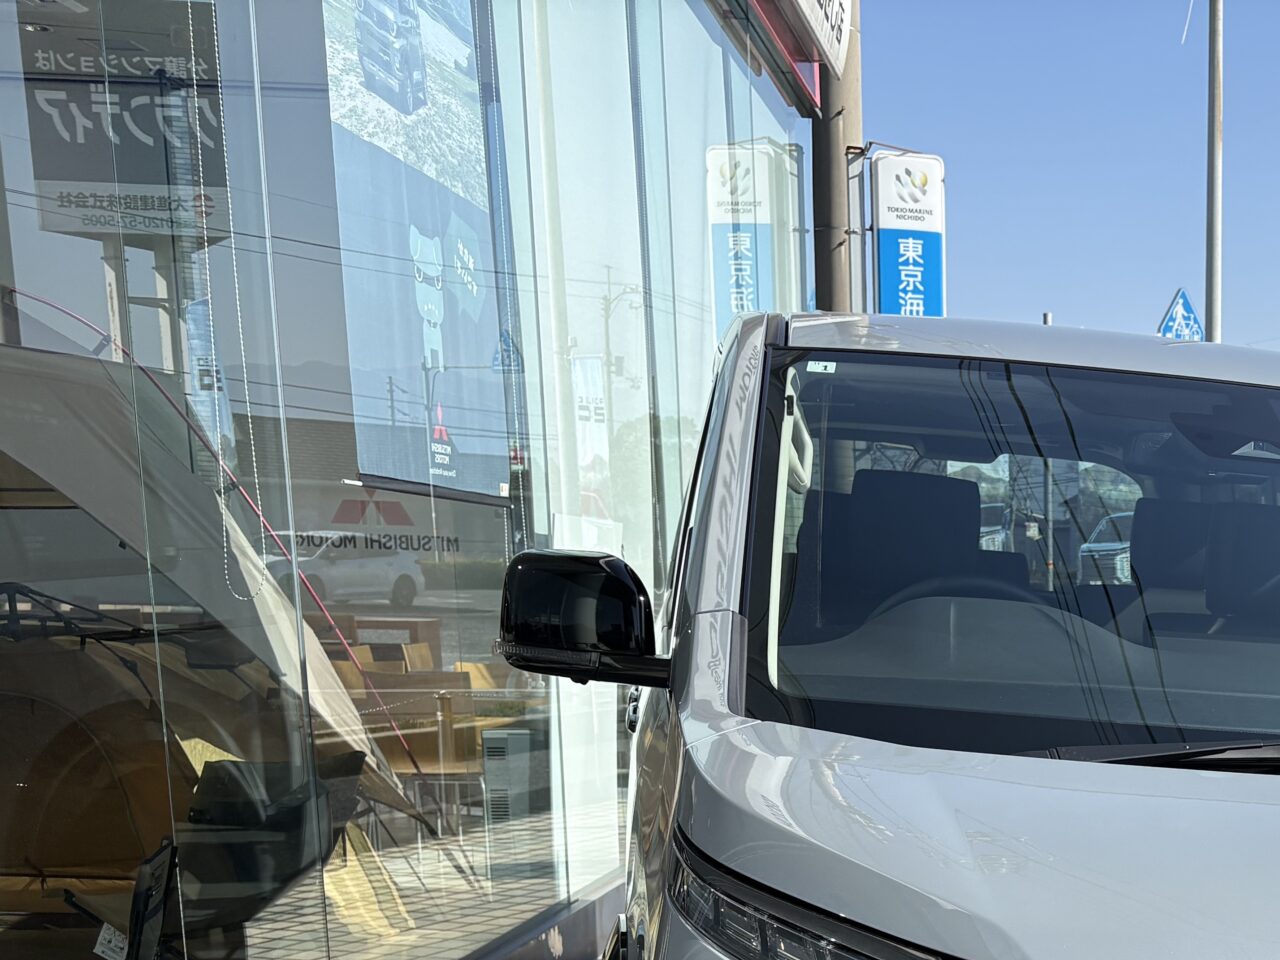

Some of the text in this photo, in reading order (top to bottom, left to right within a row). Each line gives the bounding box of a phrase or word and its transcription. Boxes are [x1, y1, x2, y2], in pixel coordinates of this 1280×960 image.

[887, 206, 933, 215] TOKIO MARINE
[896, 214, 925, 222] NICHIDO
[898, 237, 924, 317] 東京海
